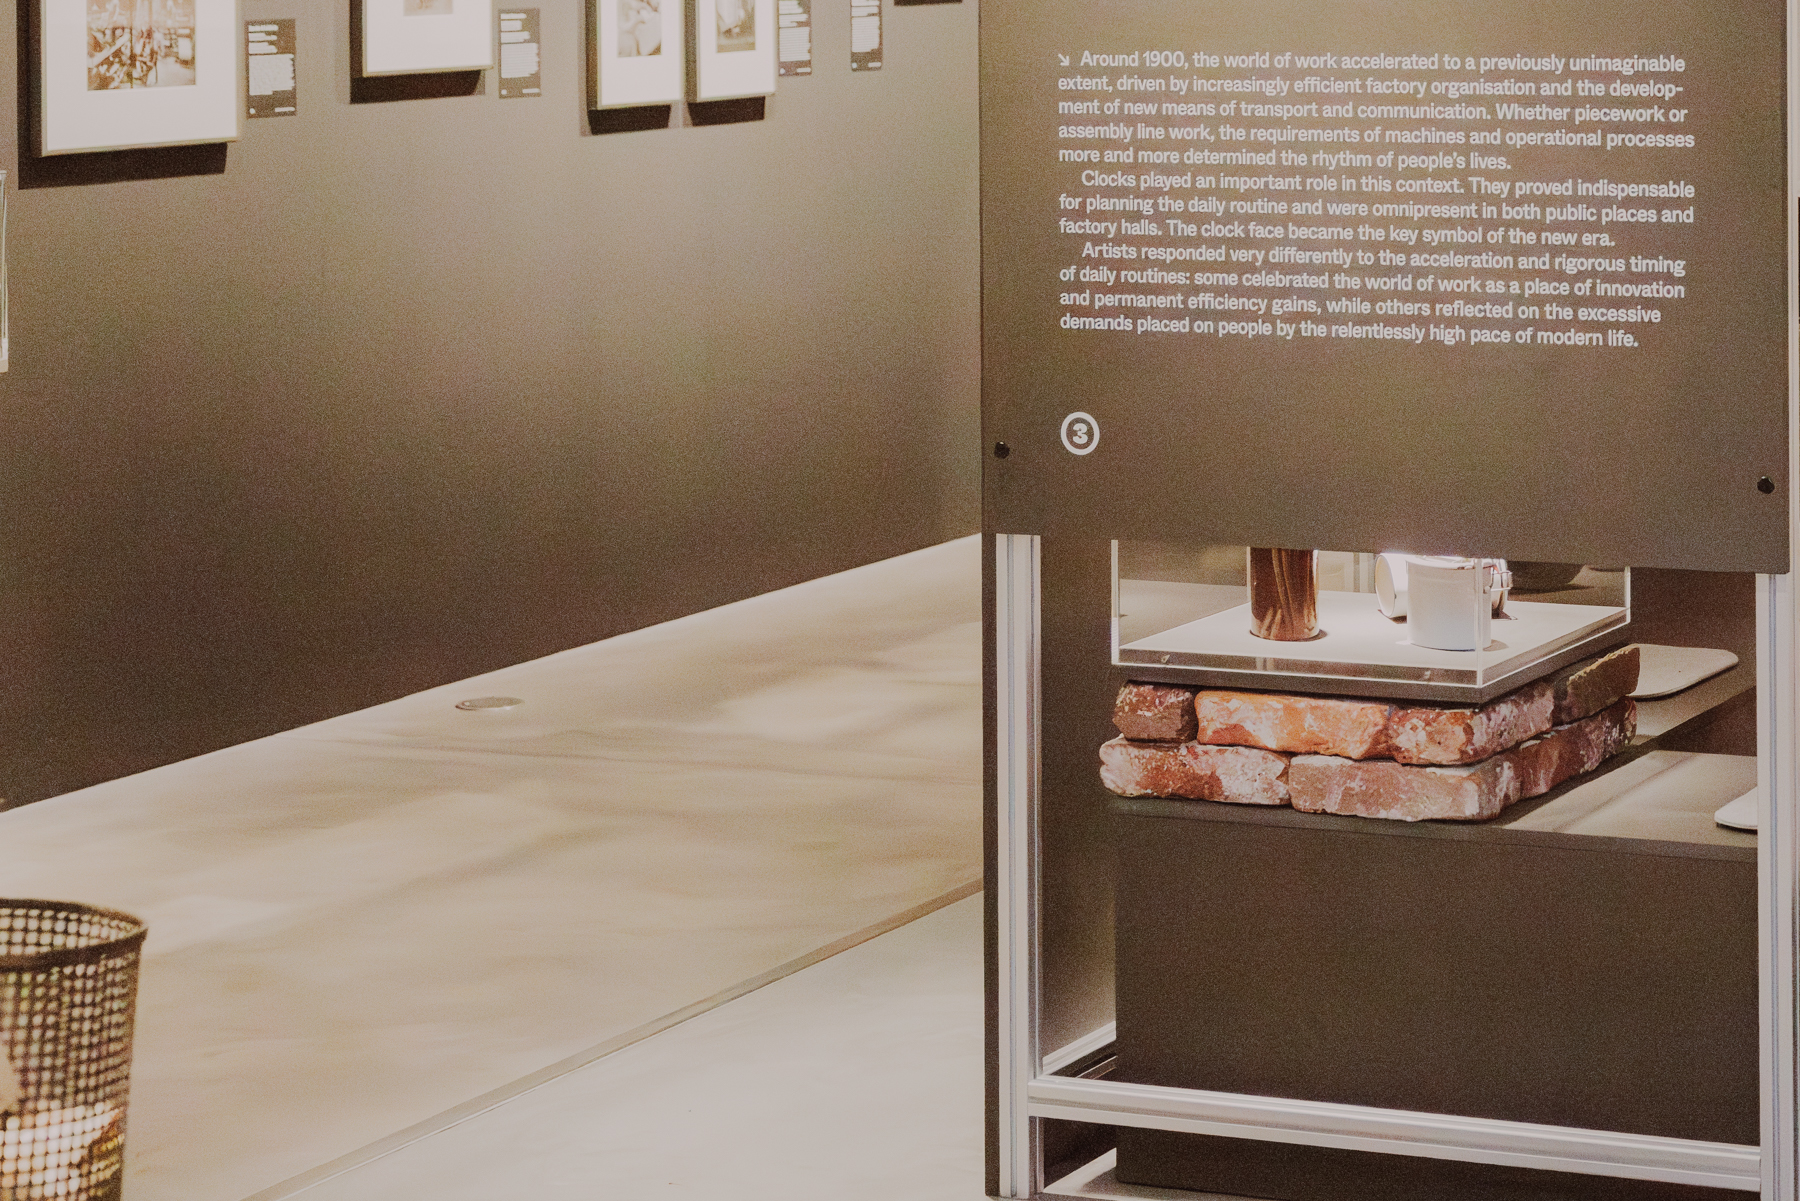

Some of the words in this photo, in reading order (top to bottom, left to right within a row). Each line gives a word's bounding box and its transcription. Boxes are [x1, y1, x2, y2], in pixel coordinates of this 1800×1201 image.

[1079, 49, 1139, 67] Around
[1142, 49, 1189, 70] 1900,
[1191, 50, 1220, 68] the
[1222, 51, 1270, 68] world
[1272, 51, 1292, 68] of
[1293, 51, 1338, 69] work
[1340, 51, 1439, 70] accelerated
[1442, 53, 1461, 70] to
[1464, 55, 1476, 70] a
[1479, 53, 1565, 74] previously
[1569, 53, 1685, 75] unimaginable
[1057, 74, 1113, 92] extent,
[1116, 73, 1166, 91] driven
[1169, 74, 1189, 95] by
[1192, 74, 1290, 96] increasingly
[1292, 75, 1362, 93] efficient
[1364, 76, 1427, 98] factory
[1430, 77, 1536, 99] organisation
[1539, 78, 1572, 96] and
[1575, 78, 1606, 96] the
[1608, 78, 1683, 101] develop-
[1058, 121, 1134, 143] assembly
[1136, 122, 1165, 139] line
[1168, 123, 1215, 142] work,
[1217, 123, 1246, 141] the
[1249, 124, 1360, 145] requirements
[1363, 125, 1382, 143] of
[1384, 126, 1466, 144] machines
[1468, 127, 1501, 145] and
[1504, 128, 1602, 148] operational
[1606, 132, 1695, 150] processes
[1080, 169, 1136, 187] Clocks
[1139, 170, 1192, 191] played
[1194, 174, 1216, 188] an
[1219, 172, 1302, 193] important
[1305, 174, 1338, 191] role
[1340, 174, 1356, 191] in
[1359, 174, 1392, 192] this
[1394, 176, 1464, 193] context.
[1467, 175, 1510, 198] They
[1514, 178, 1573, 198] proved
[1576, 178, 1695, 200] indispensable
[1081, 240, 1137, 259] Artists
[1140, 243, 1226, 263] responded
[1228, 248, 1265, 266] very
[1267, 245, 1353, 268] differently
[1355, 248, 1375, 265] to
[1377, 248, 1406, 266] the
[1409, 249, 1513, 269] acceleration
[1517, 252, 1550, 269] and
[1554, 252, 1626, 274] rigorous
[1628, 254, 1686, 276] timing
[1059, 288, 1090, 306] and
[1094, 292, 1184, 309] permanent
[1186, 291, 1268, 314] efficiency
[1270, 294, 1322, 315] gains,
[1325, 296, 1371, 314] while
[1374, 298, 1431, 316] others
[1434, 299, 1513, 318] reflected
[1516, 305, 1540, 319] on
[1543, 301, 1573, 320] the
[1577, 304, 1661, 322] excessive
